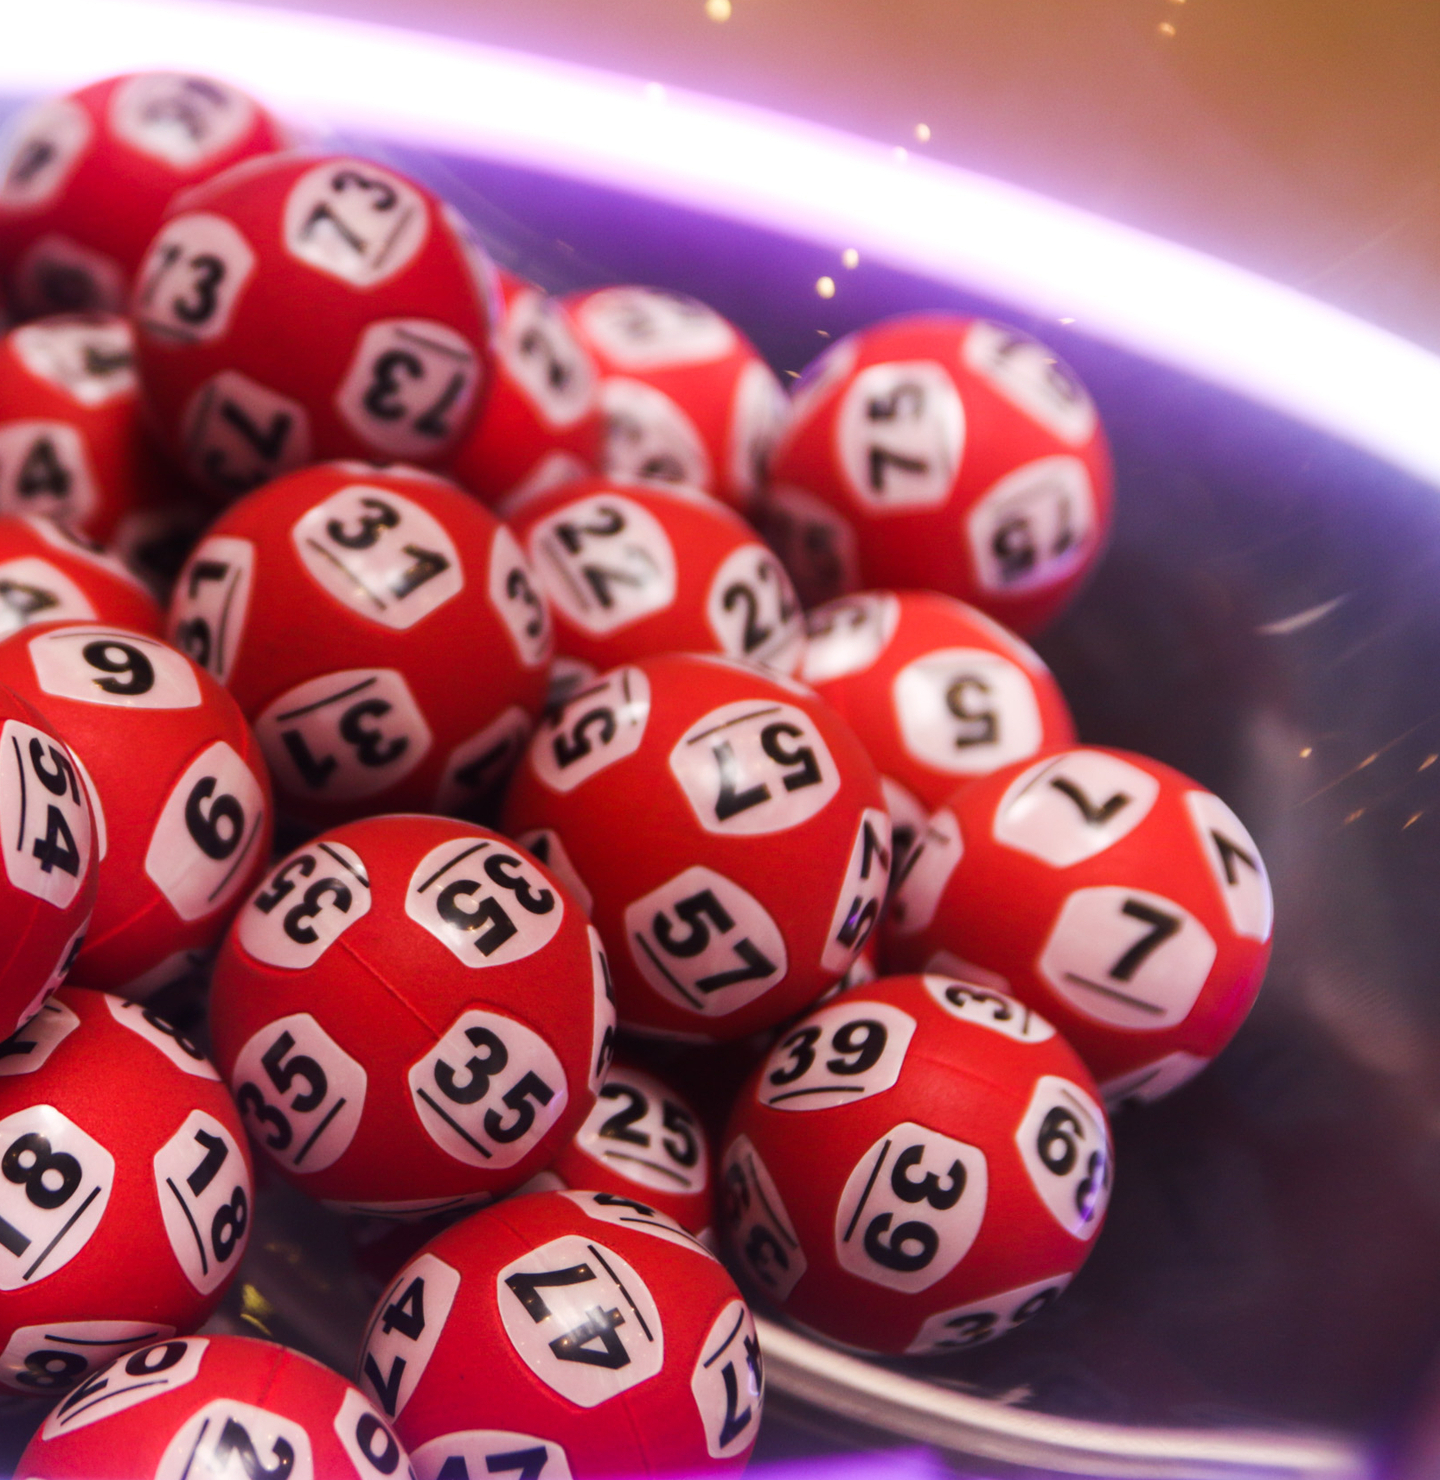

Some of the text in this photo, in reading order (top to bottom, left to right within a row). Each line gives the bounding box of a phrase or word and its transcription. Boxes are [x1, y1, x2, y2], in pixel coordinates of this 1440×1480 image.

[298, 170, 398, 256] 73
[364, 350, 466, 438] 73
[866, 382, 928, 496] 75
[326, 497, 450, 599] 31
[281, 699, 410, 789] 31
[944, 672, 1002, 749] 5
[28, 736, 81, 879] 54
[711, 722, 823, 822] 57
[1050, 776, 1132, 826] 7
[254, 854, 353, 945] 35
[436, 853, 555, 957] 35
[652, 888, 777, 994] 57
[1121, 898, 1182, 982] 7
[237, 1030, 328, 1152] 35
[433, 1026, 556, 1144] 35
[769, 1019, 888, 1086] 39
[596, 1083, 699, 1169] 25
[186, 1128, 248, 1263] 18
[863, 1144, 967, 1272] 39
[363, 1276, 425, 1418] 47
[504, 1262, 632, 1370] 47
[56, 1340, 188, 1419] 20
